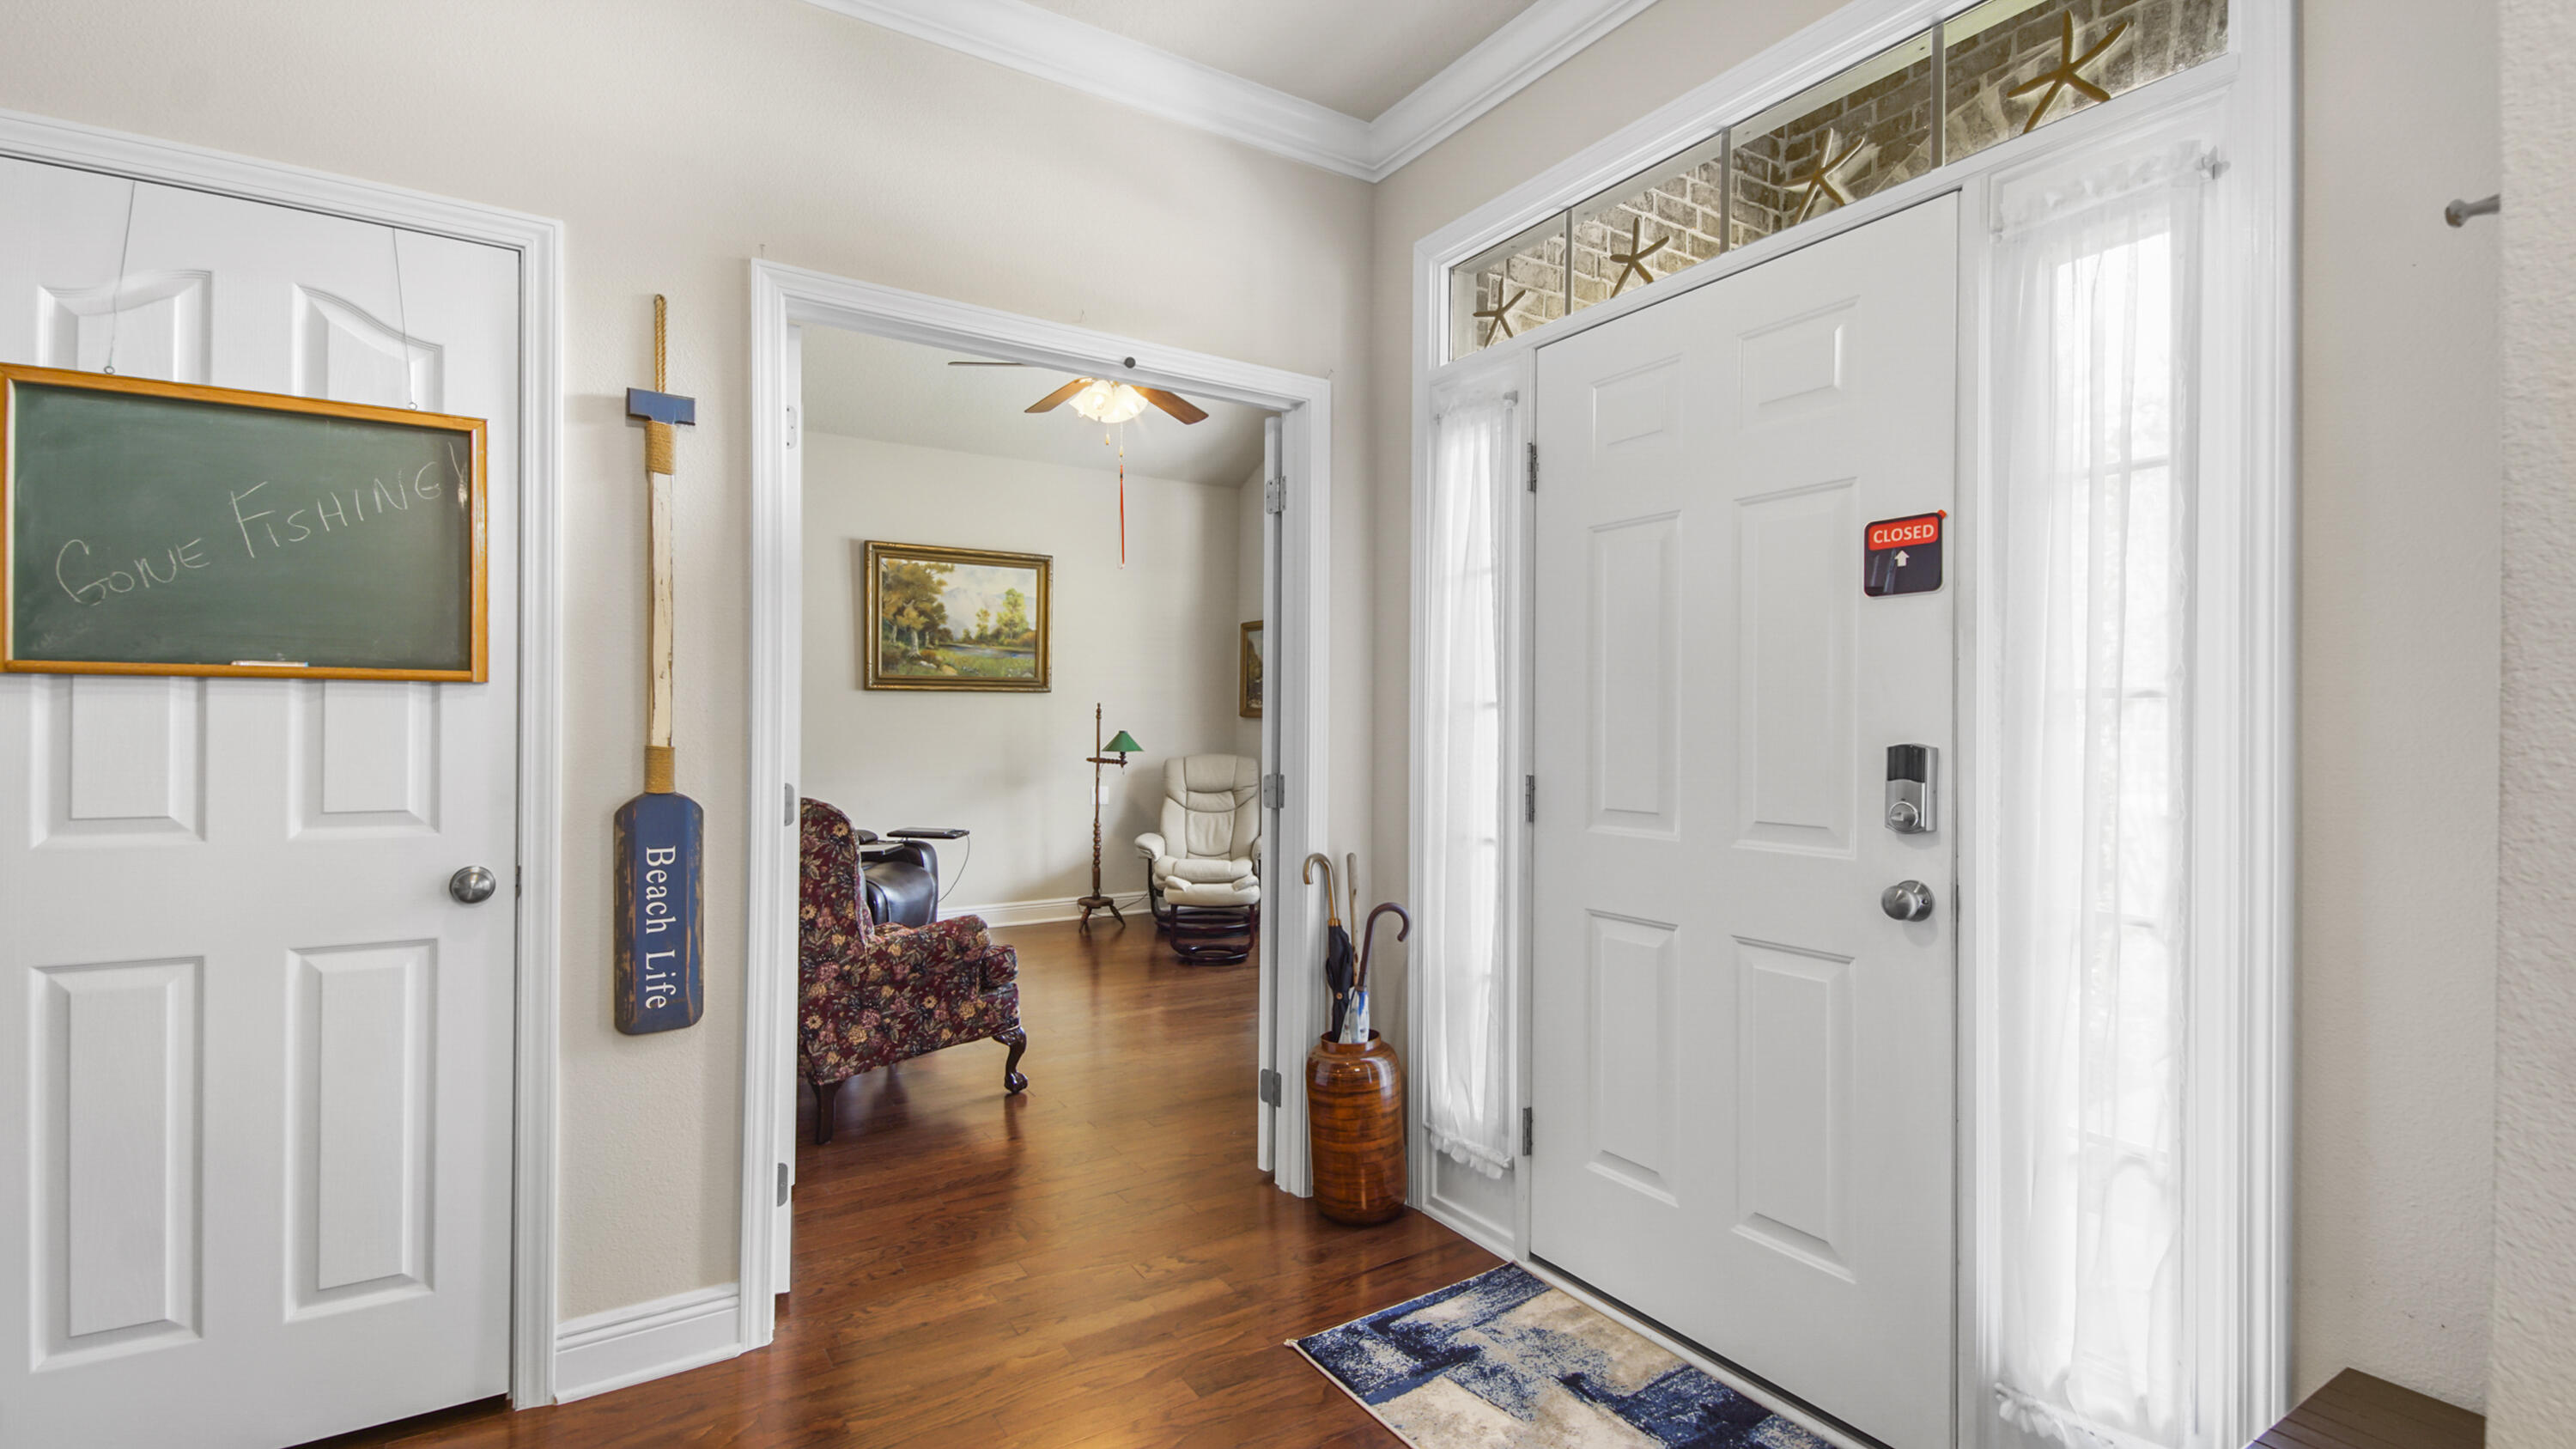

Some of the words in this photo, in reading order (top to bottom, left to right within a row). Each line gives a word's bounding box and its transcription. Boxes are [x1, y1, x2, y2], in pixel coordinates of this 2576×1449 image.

[1873, 524, 1935, 544] CLOSED
[645, 845, 677, 935] Beach
[645, 950, 677, 1009] Life
